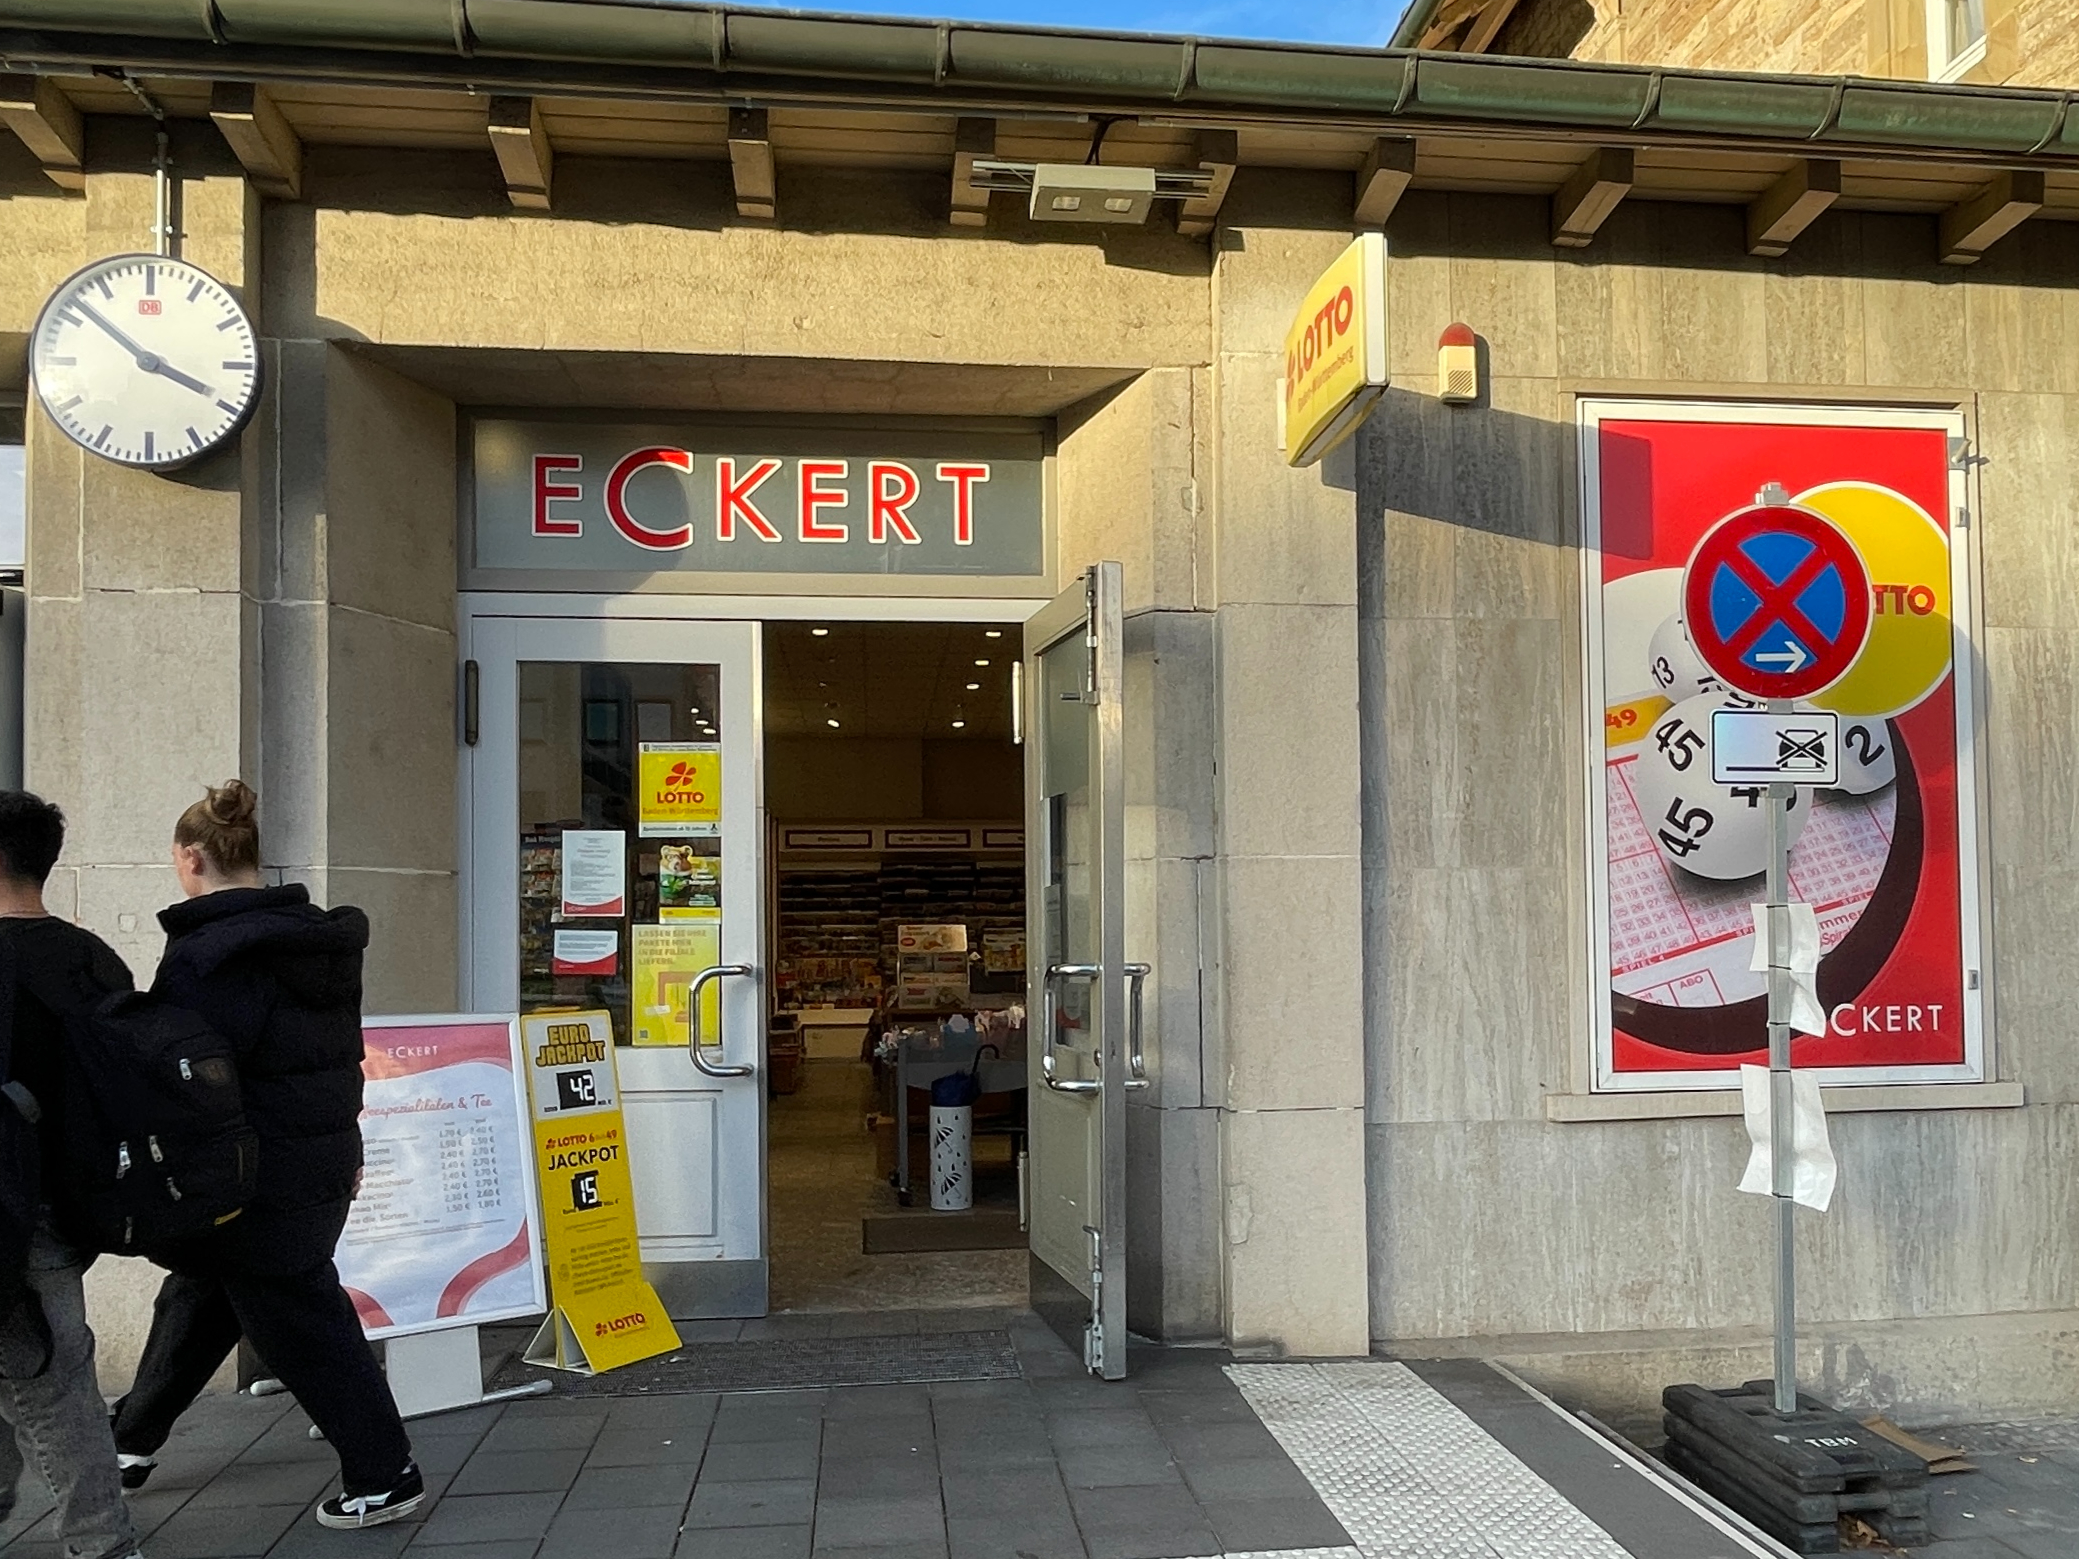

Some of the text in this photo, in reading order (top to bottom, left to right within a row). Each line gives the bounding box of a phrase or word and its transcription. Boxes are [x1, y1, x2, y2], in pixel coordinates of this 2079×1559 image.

[140, 300, 161, 314] DB
[1298, 286, 1353, 384] LOTTO
[532, 445, 990, 551] ECKERT
[1872, 585, 1936, 615] TTO
[1651, 656, 1675, 689] 13
[1606, 708, 1638, 729] 49
[1655, 718, 1706, 771] 45
[1845, 725, 1886, 767] 2
[656, 791, 705, 805] LOTTO
[1658, 796, 1714, 858] 45
[1819, 909, 1863, 930] mmer
[638, 939, 670, 947] PAKETE
[1679, 975, 1704, 990] ABO
[1830, 1003, 1943, 1037] CKERT
[547, 1023, 591, 1047] EURO
[387, 1045, 438, 1059] ECKERT
[536, 1040, 606, 1067] JACKPOT
[569, 1074, 595, 1101] 42
[457, 1096, 468, 1110] &
[470, 1093, 493, 1108] Tee
[557, 1134, 588, 1148] LOTTO
[588, 1133, 596, 1143] 6
[606, 1129, 618, 1140] 49
[548, 1145, 620, 1171] JACKPOT
[580, 1176, 599, 1205] 15
[607, 1312, 646, 1332] LOTTO
